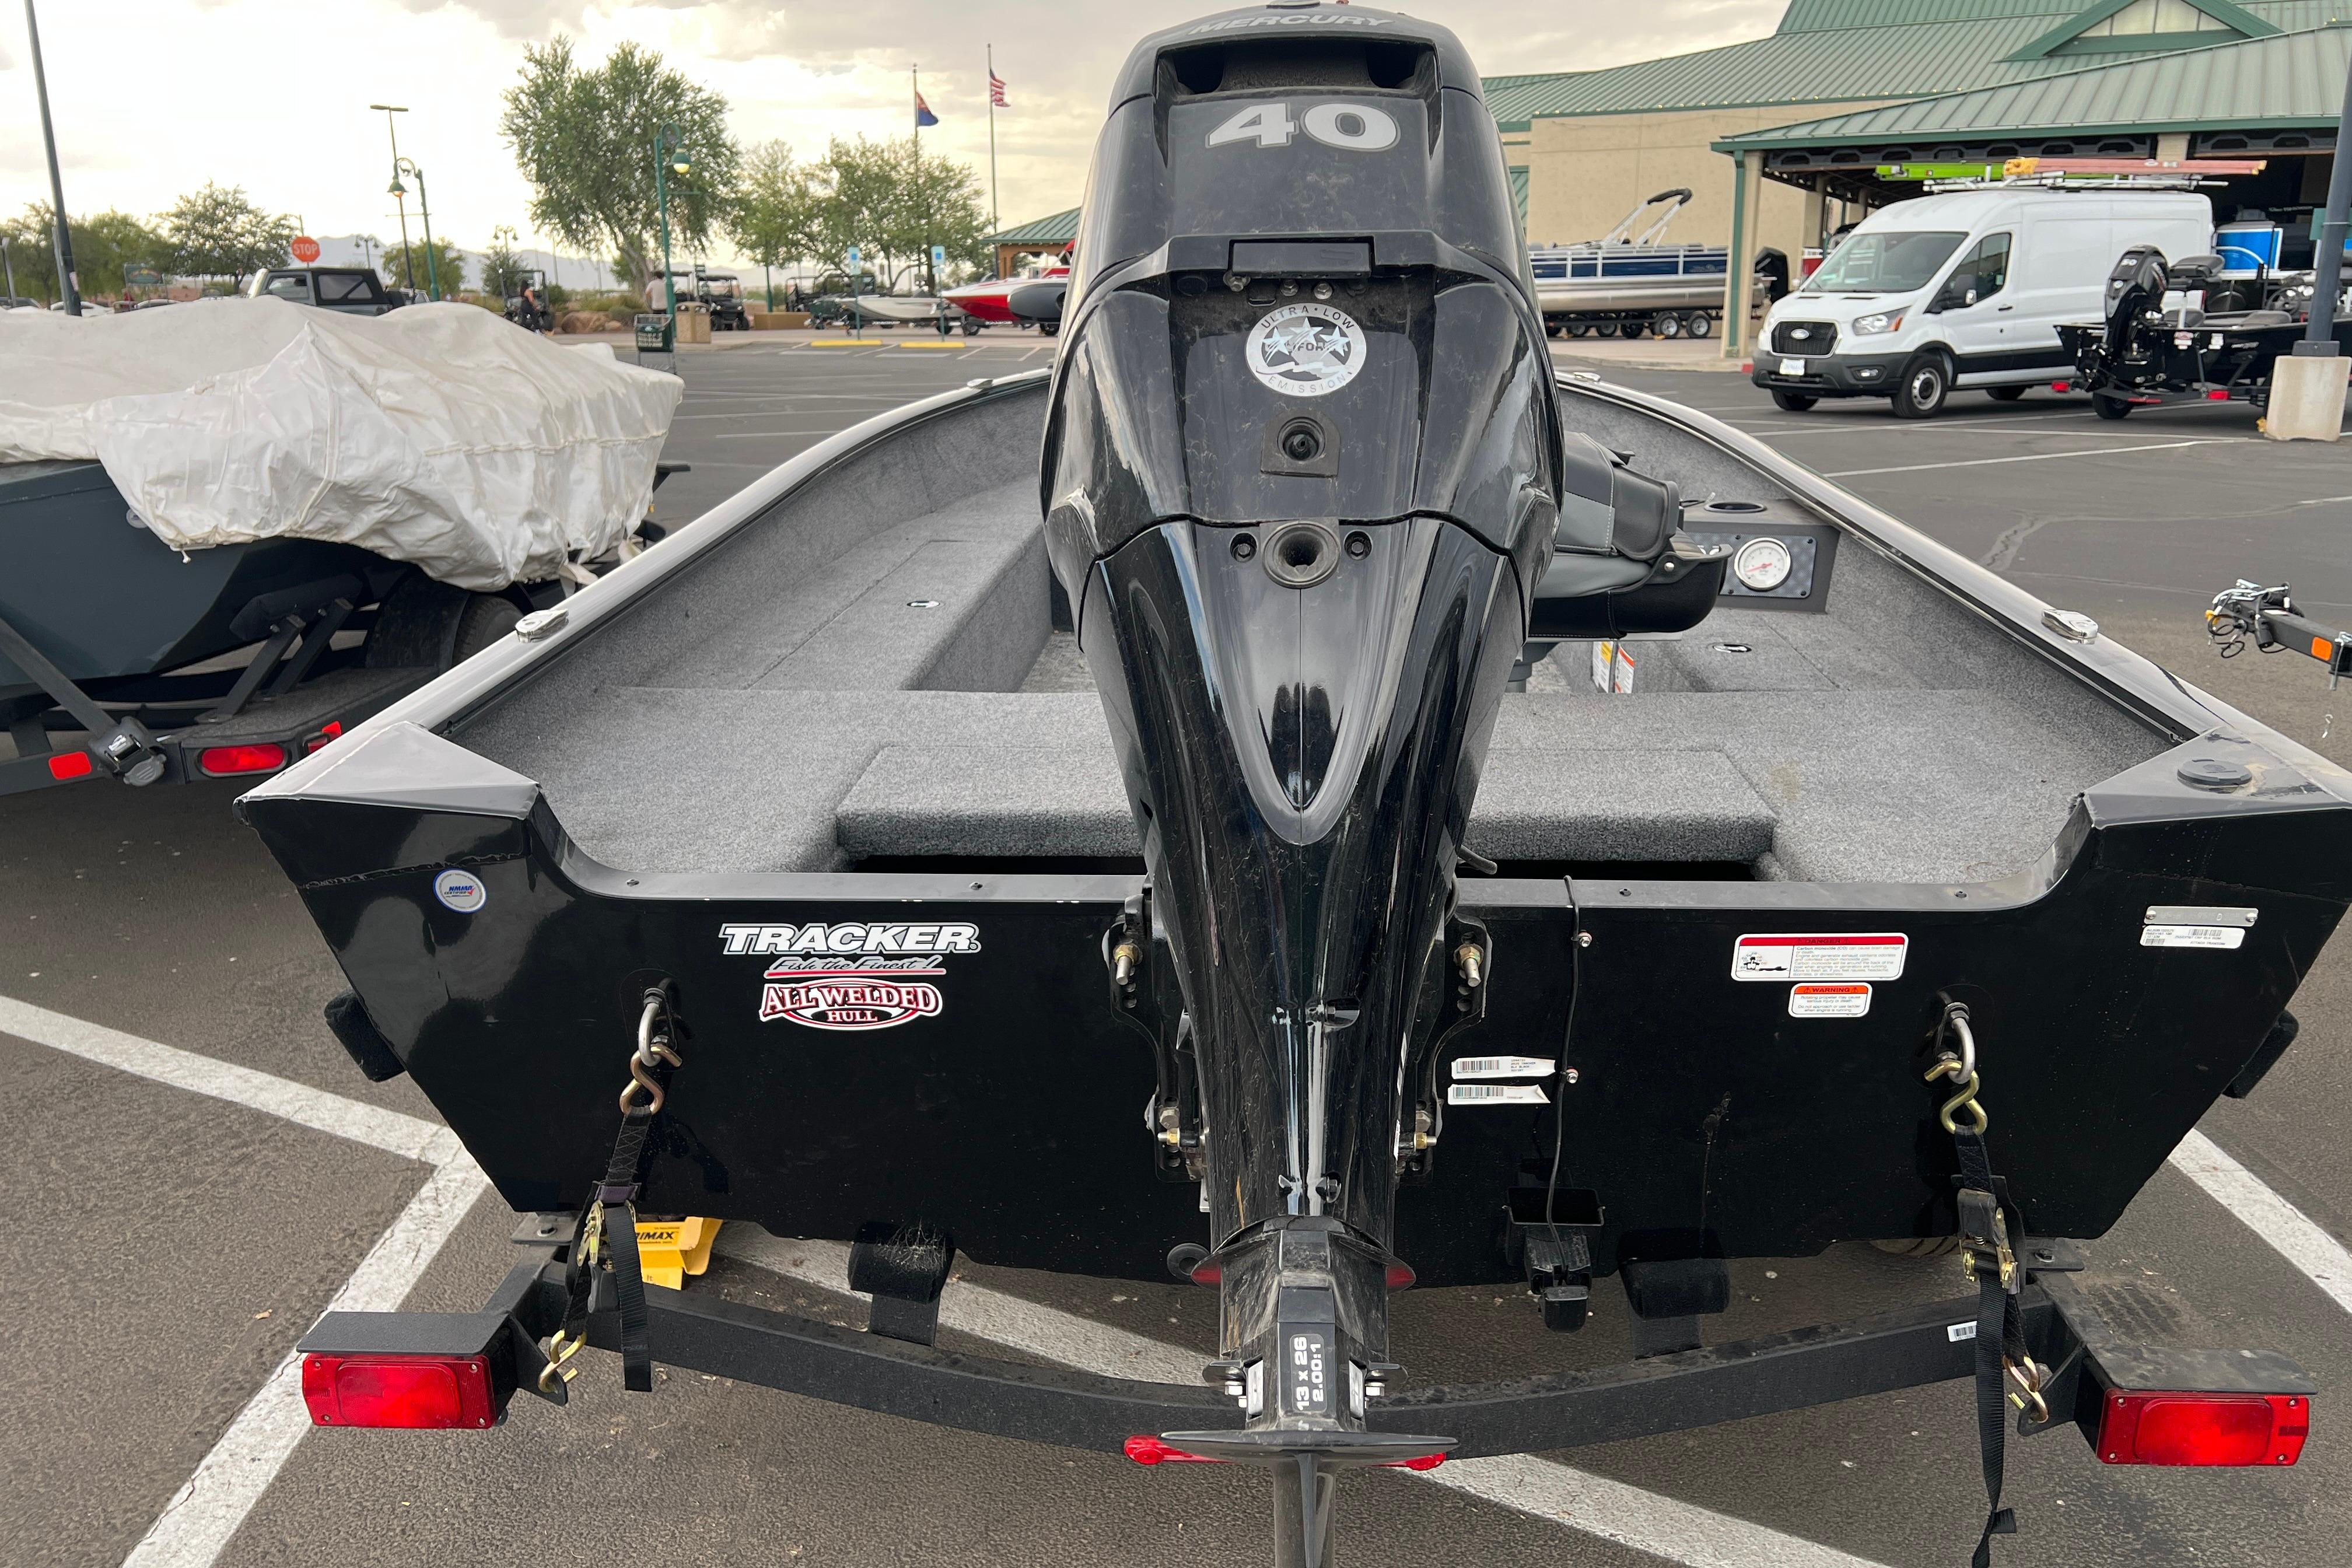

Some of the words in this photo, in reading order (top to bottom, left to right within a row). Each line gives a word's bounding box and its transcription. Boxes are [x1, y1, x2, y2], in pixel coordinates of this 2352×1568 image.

[1186, 15, 1397, 36] MERCURY
[1207, 103, 1399, 151] 40
[293, 243, 318, 256] STOP
[1261, 305, 1309, 329] ULTRA
[1323, 307, 1355, 330] LOW
[773, 958, 817, 970] Fish
[820, 957, 853, 970] the
[762, 986, 817, 1016] ALL
[818, 986, 938, 1012] WELDED
[826, 1010, 878, 1023] HULL
[636, 1231, 674, 1240] IMAX
[1294, 1337, 1308, 1365] 26
[1298, 1370, 1308, 1381] x
[1310, 1343, 1324, 1402] 2.00:1
[1296, 1386, 1310, 1410] 13
